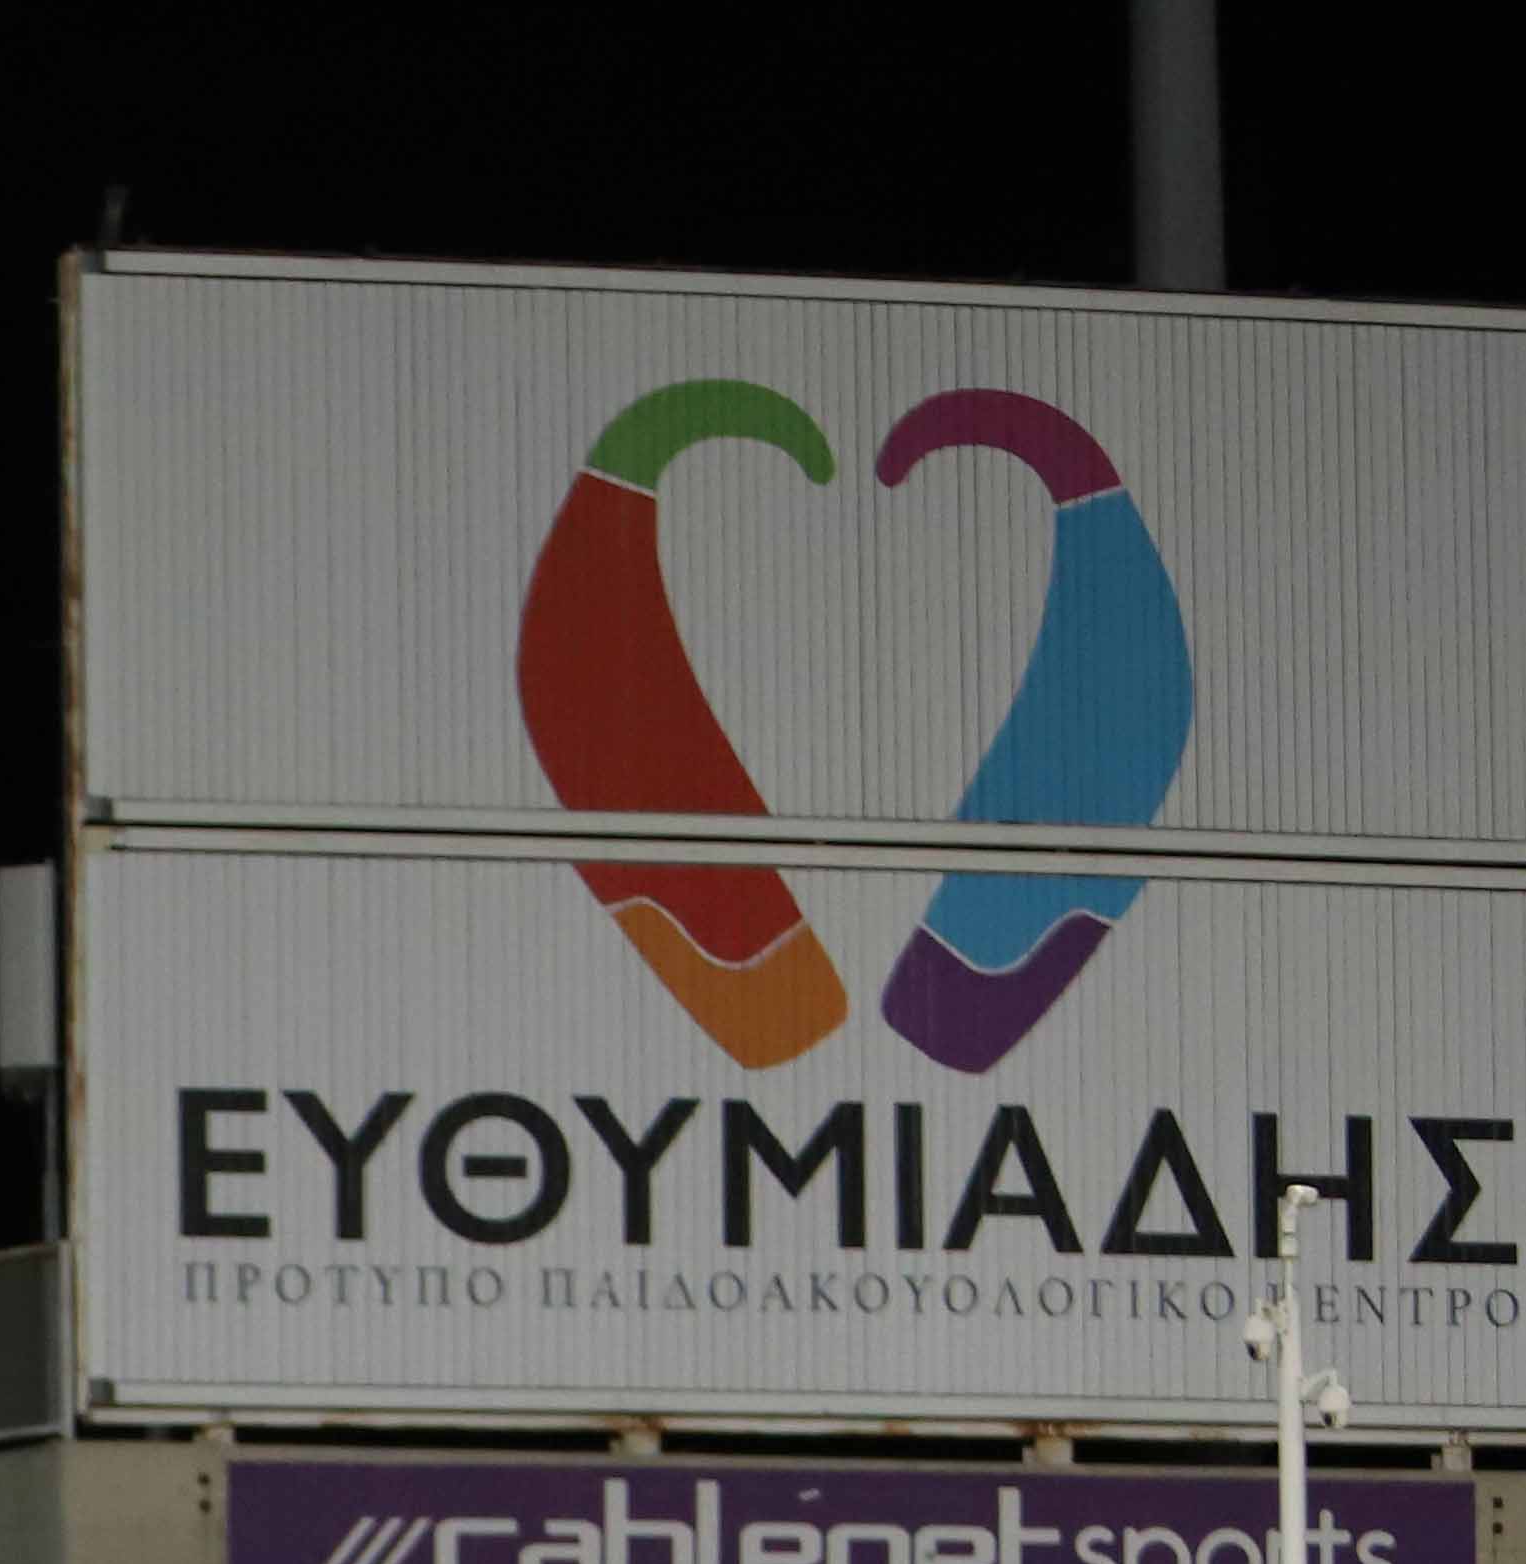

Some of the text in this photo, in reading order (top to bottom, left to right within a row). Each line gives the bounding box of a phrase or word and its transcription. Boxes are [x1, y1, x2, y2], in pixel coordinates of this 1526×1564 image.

[177, 1087, 1518, 1265] ΕΥΘΥΜΙΑΔΗΣ
[183, 1261, 505, 1309] ΠΡΟΤΥΠΟ
[539, 1266, 1237, 1322] ΠΑΙΔΟΑΚΟΥΟΛΟΓΙΚΟ
